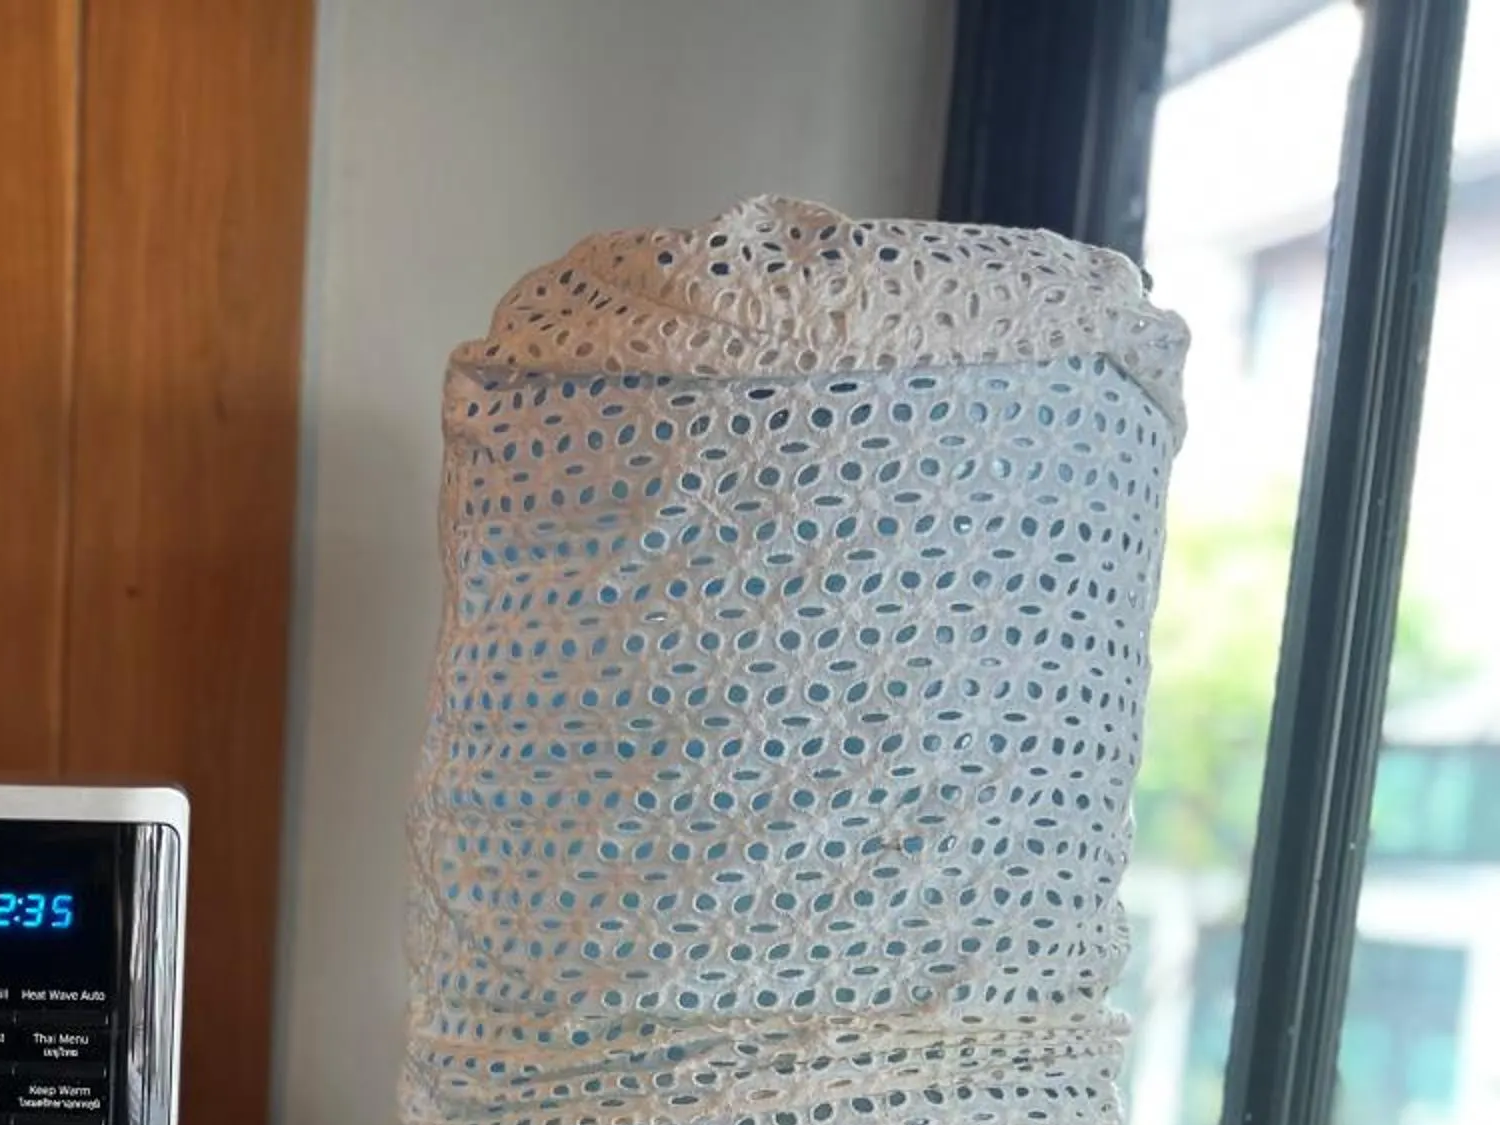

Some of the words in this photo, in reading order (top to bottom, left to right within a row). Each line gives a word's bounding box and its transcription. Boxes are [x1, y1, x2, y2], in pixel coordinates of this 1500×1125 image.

[21, 989, 46, 1001] Heat
[48, 989, 78, 1001] Wave
[80, 989, 106, 1001] Auto
[33, 1032, 57, 1044] Thai
[59, 1033, 89, 1045] Menu
[29, 1085, 56, 1098] Keep
[58, 1086, 91, 1097] Warm
